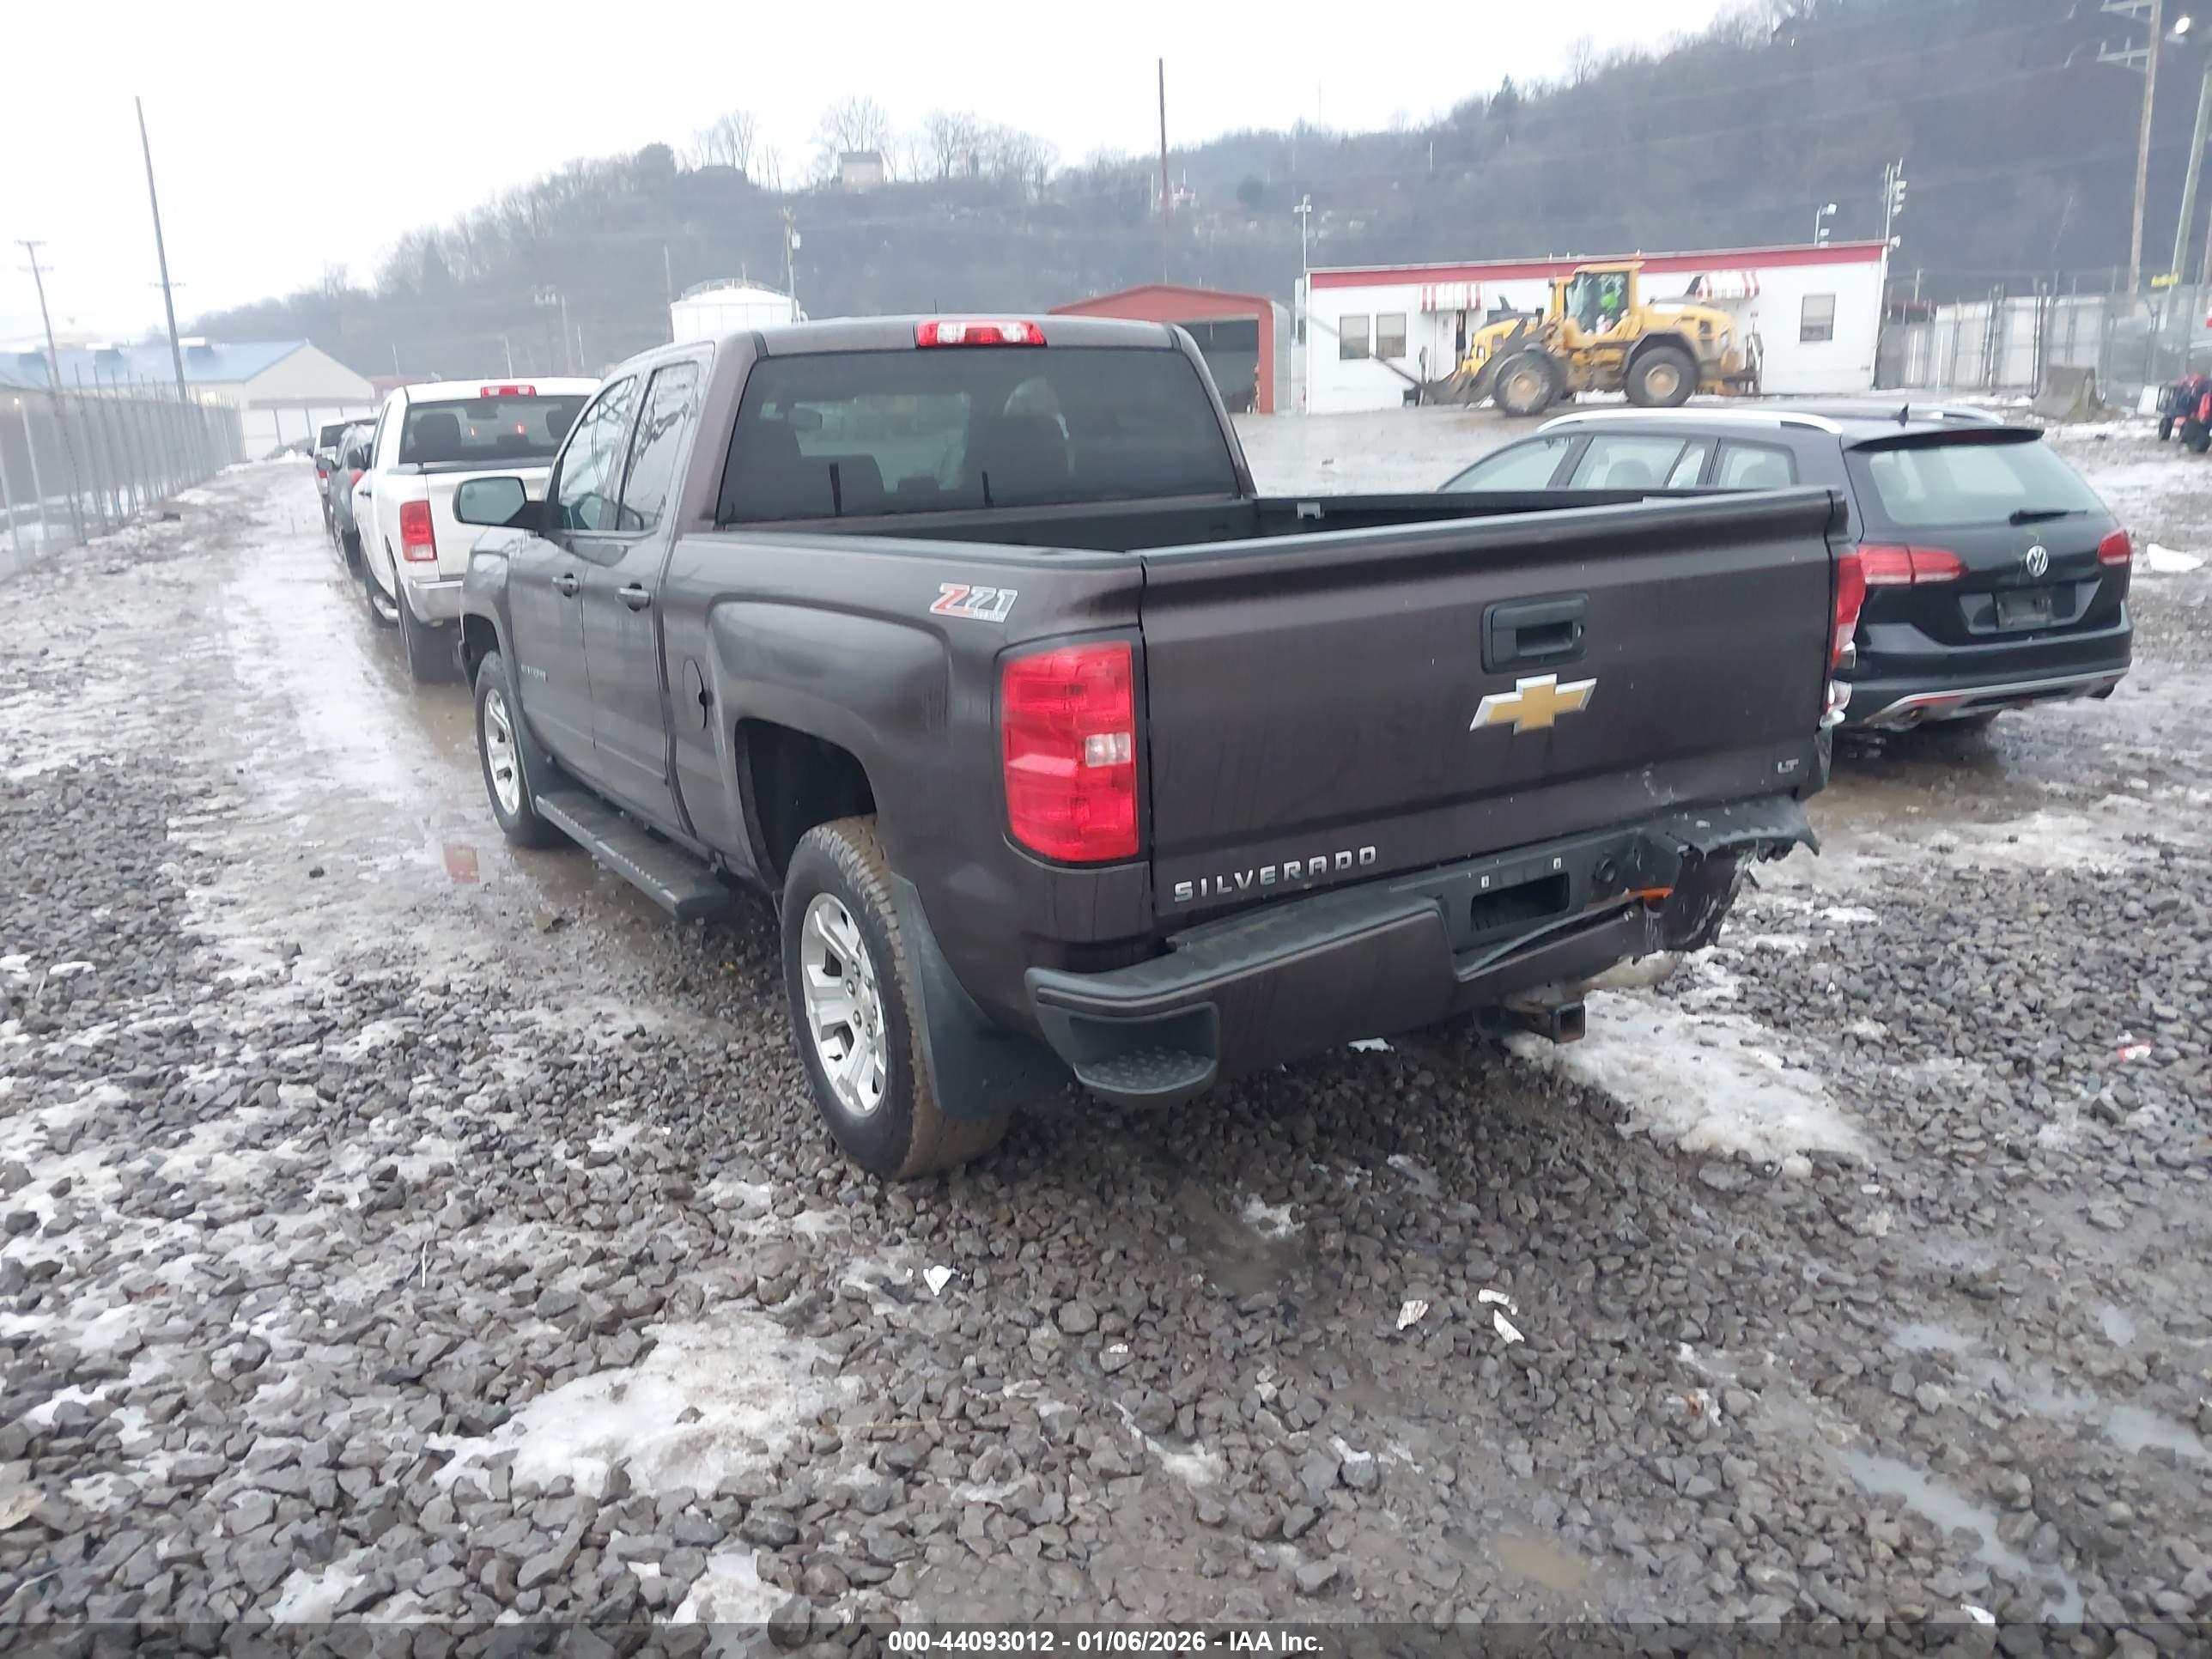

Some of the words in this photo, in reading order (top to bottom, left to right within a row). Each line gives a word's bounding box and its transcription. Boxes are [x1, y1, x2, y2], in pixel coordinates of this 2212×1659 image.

[929, 583, 1018, 623] Z71
[1778, 758, 1799, 774] LT
[1174, 846, 1376, 902] SILVERADO
